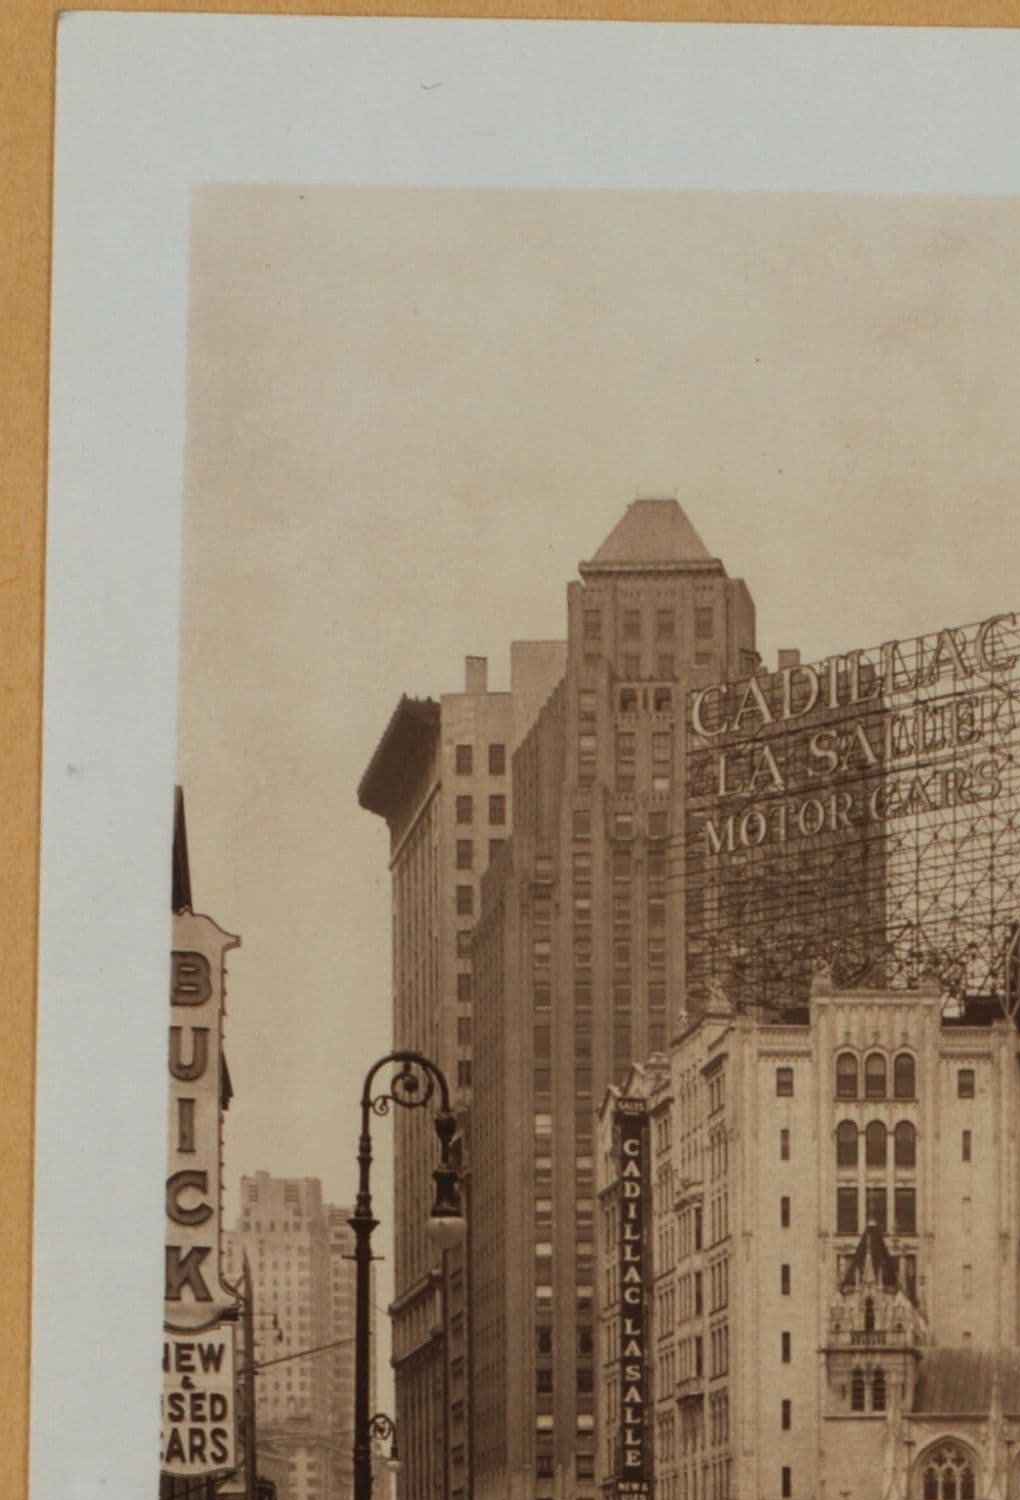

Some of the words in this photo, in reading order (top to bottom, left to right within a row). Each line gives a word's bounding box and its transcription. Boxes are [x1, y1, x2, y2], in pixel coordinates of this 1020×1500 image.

[691, 612, 1017, 737] CADILLAC
[717, 744, 785, 798] LA
[807, 697, 983, 777] SALLE
[703, 790, 856, 855] MOTOR
[870, 758, 1002, 822] CARS
[164, 950, 214, 1301] BUICK
[622, 1138, 642, 1305] CADILLAC
[160, 1427, 228, 1464] ARS
[161, 1392, 228, 1423] SED
